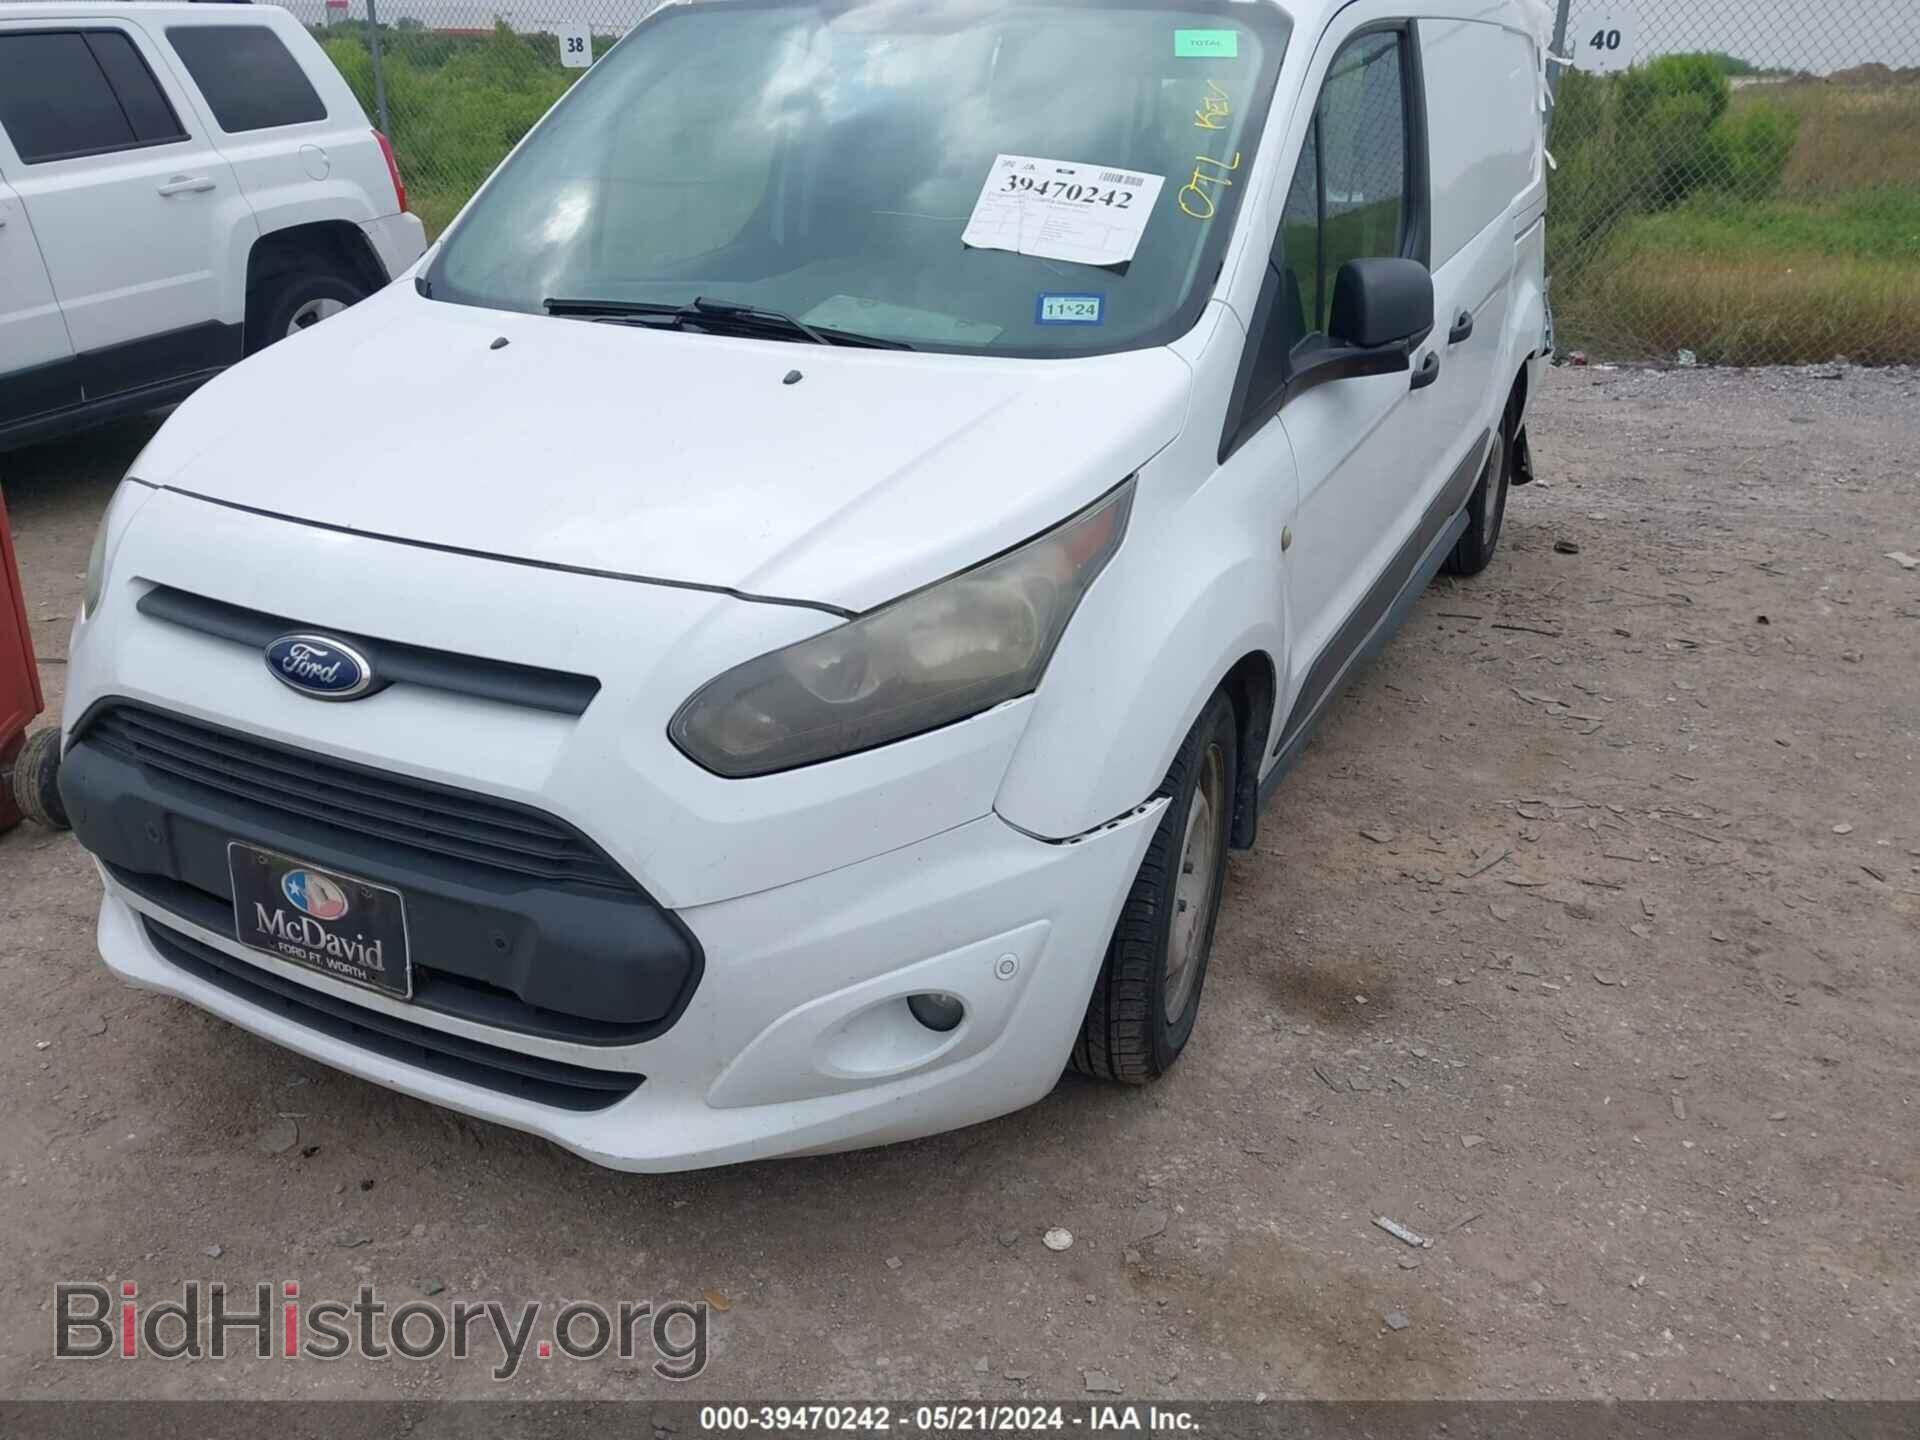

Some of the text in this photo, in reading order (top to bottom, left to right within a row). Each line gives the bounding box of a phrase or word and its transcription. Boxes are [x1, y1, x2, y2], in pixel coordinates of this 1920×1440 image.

[567, 37, 584, 52] 38
[1589, 29, 1621, 50] 40
[1000, 174, 1133, 209] 39470242
[282, 642, 341, 683] Ford
[254, 901, 386, 972] McDavid
[278, 942, 307, 960] FORD
[325, 957, 368, 980] WORTH
